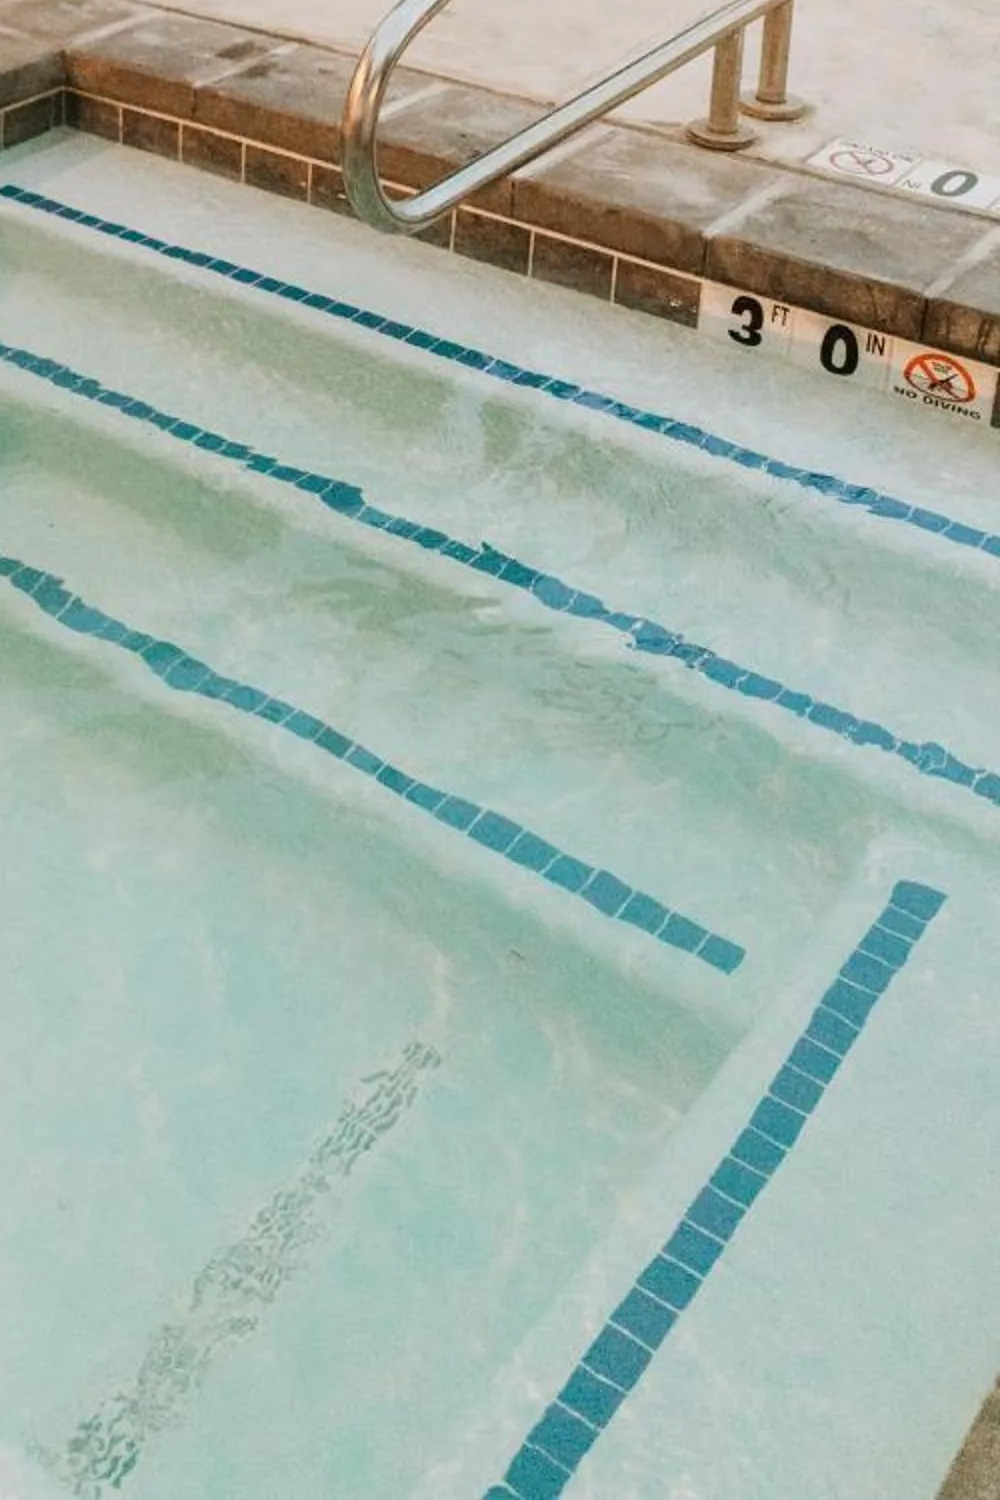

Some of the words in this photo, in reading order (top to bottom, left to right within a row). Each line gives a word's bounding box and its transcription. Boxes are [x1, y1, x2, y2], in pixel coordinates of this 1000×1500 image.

[930, 169, 979, 198] 0
[727, 295, 764, 347] 3
[770, 304, 791, 327] FT
[819, 323, 860, 377] 0
[865, 332, 886, 357] IN
[893, 385, 918, 399] NO
[923, 394, 981, 420] DIVING
